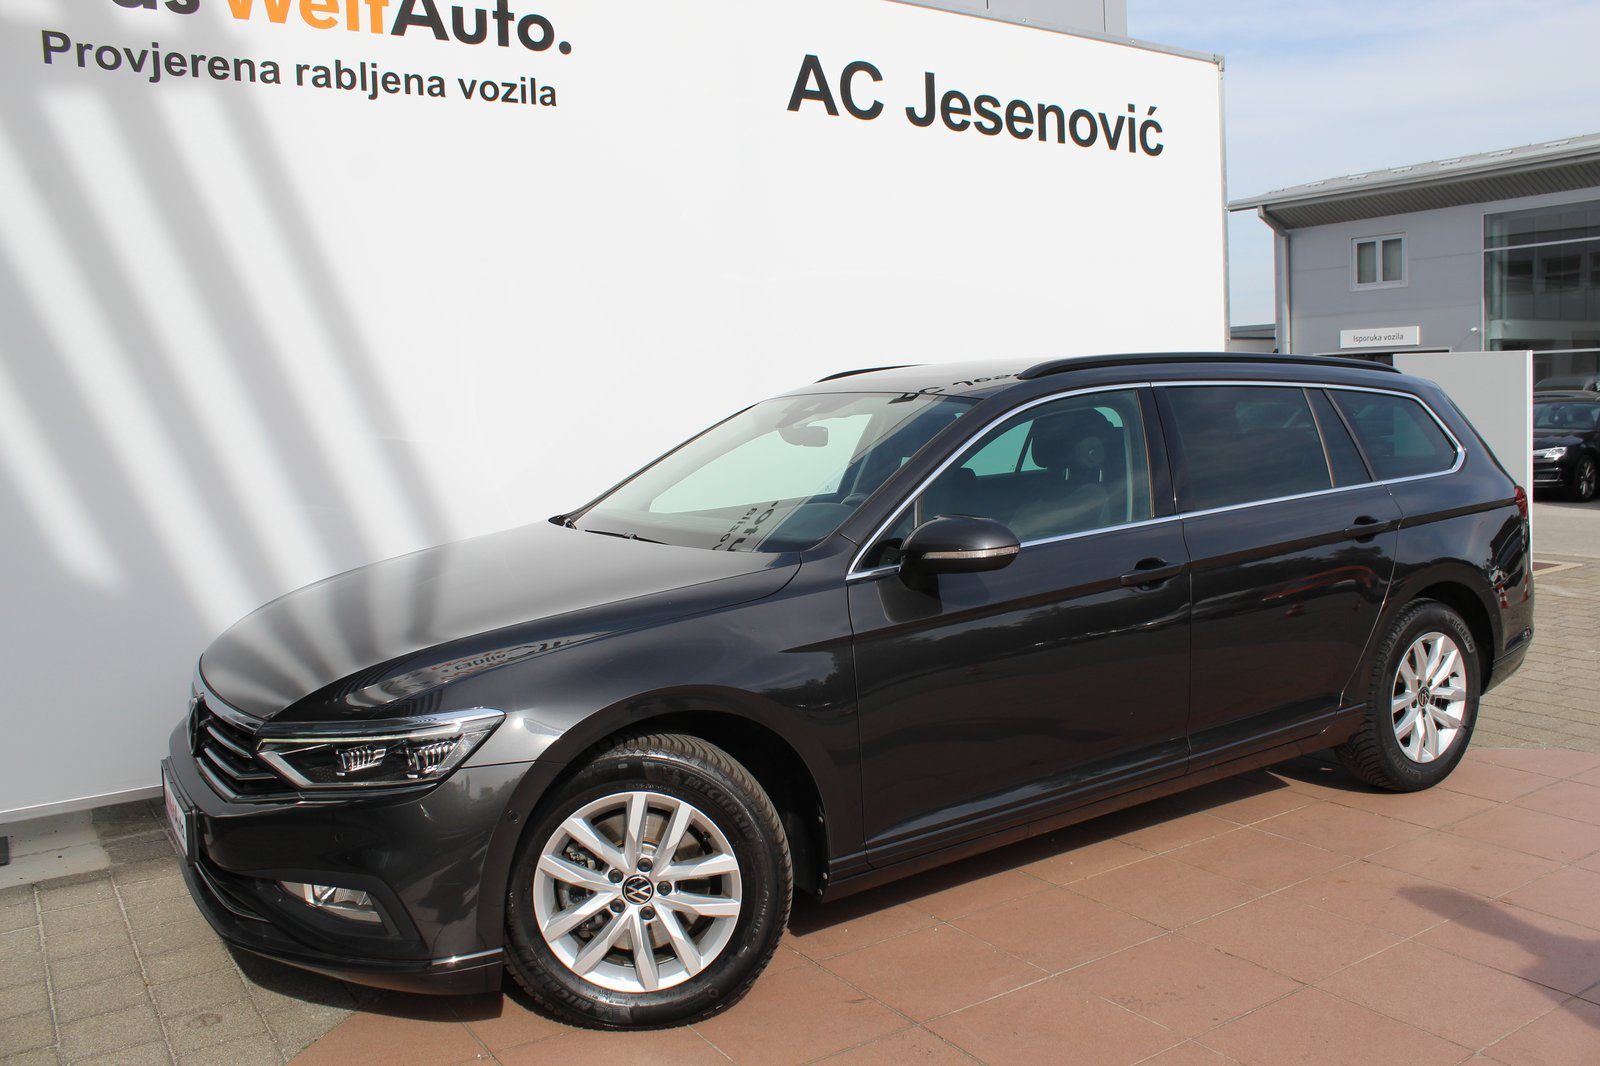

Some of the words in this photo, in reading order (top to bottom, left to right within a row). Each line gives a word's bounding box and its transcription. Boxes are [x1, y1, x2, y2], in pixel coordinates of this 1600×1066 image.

[42, 30, 280, 84] Provjerena
[296, 59, 446, 100] rabljena
[458, 76, 557, 107] vozila
[787, 55, 884, 121] AC
[905, 71, 1164, 157] Jesenović
[1353, 333, 1382, 343] Isporuka
[1383, 332, 1404, 341] vozila
